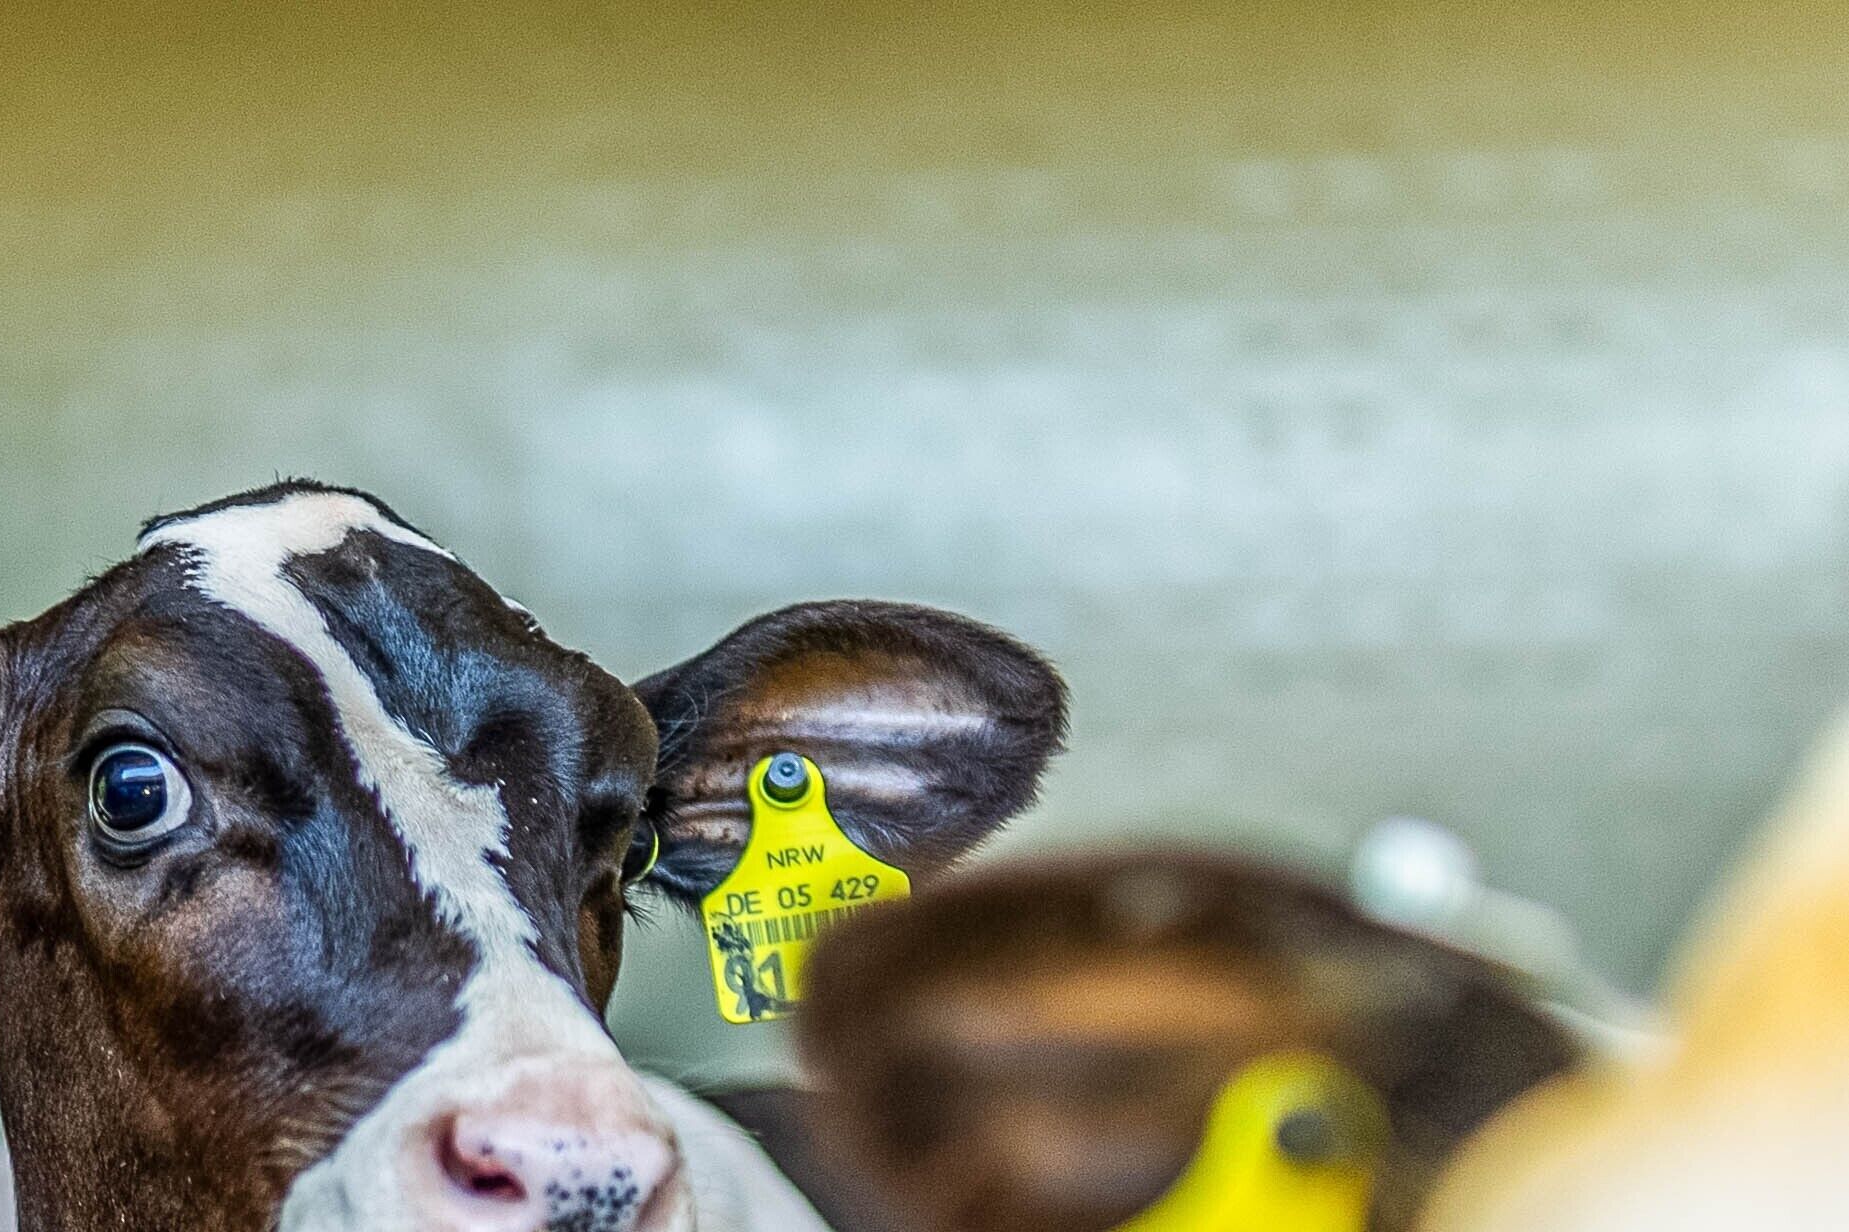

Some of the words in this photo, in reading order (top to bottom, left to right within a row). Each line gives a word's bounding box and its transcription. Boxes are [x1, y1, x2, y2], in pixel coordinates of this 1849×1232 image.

[766, 845, 825, 869] NRW
[726, 891, 763, 917] DE
[777, 884, 812, 910] 05
[830, 875, 880, 902] 429
